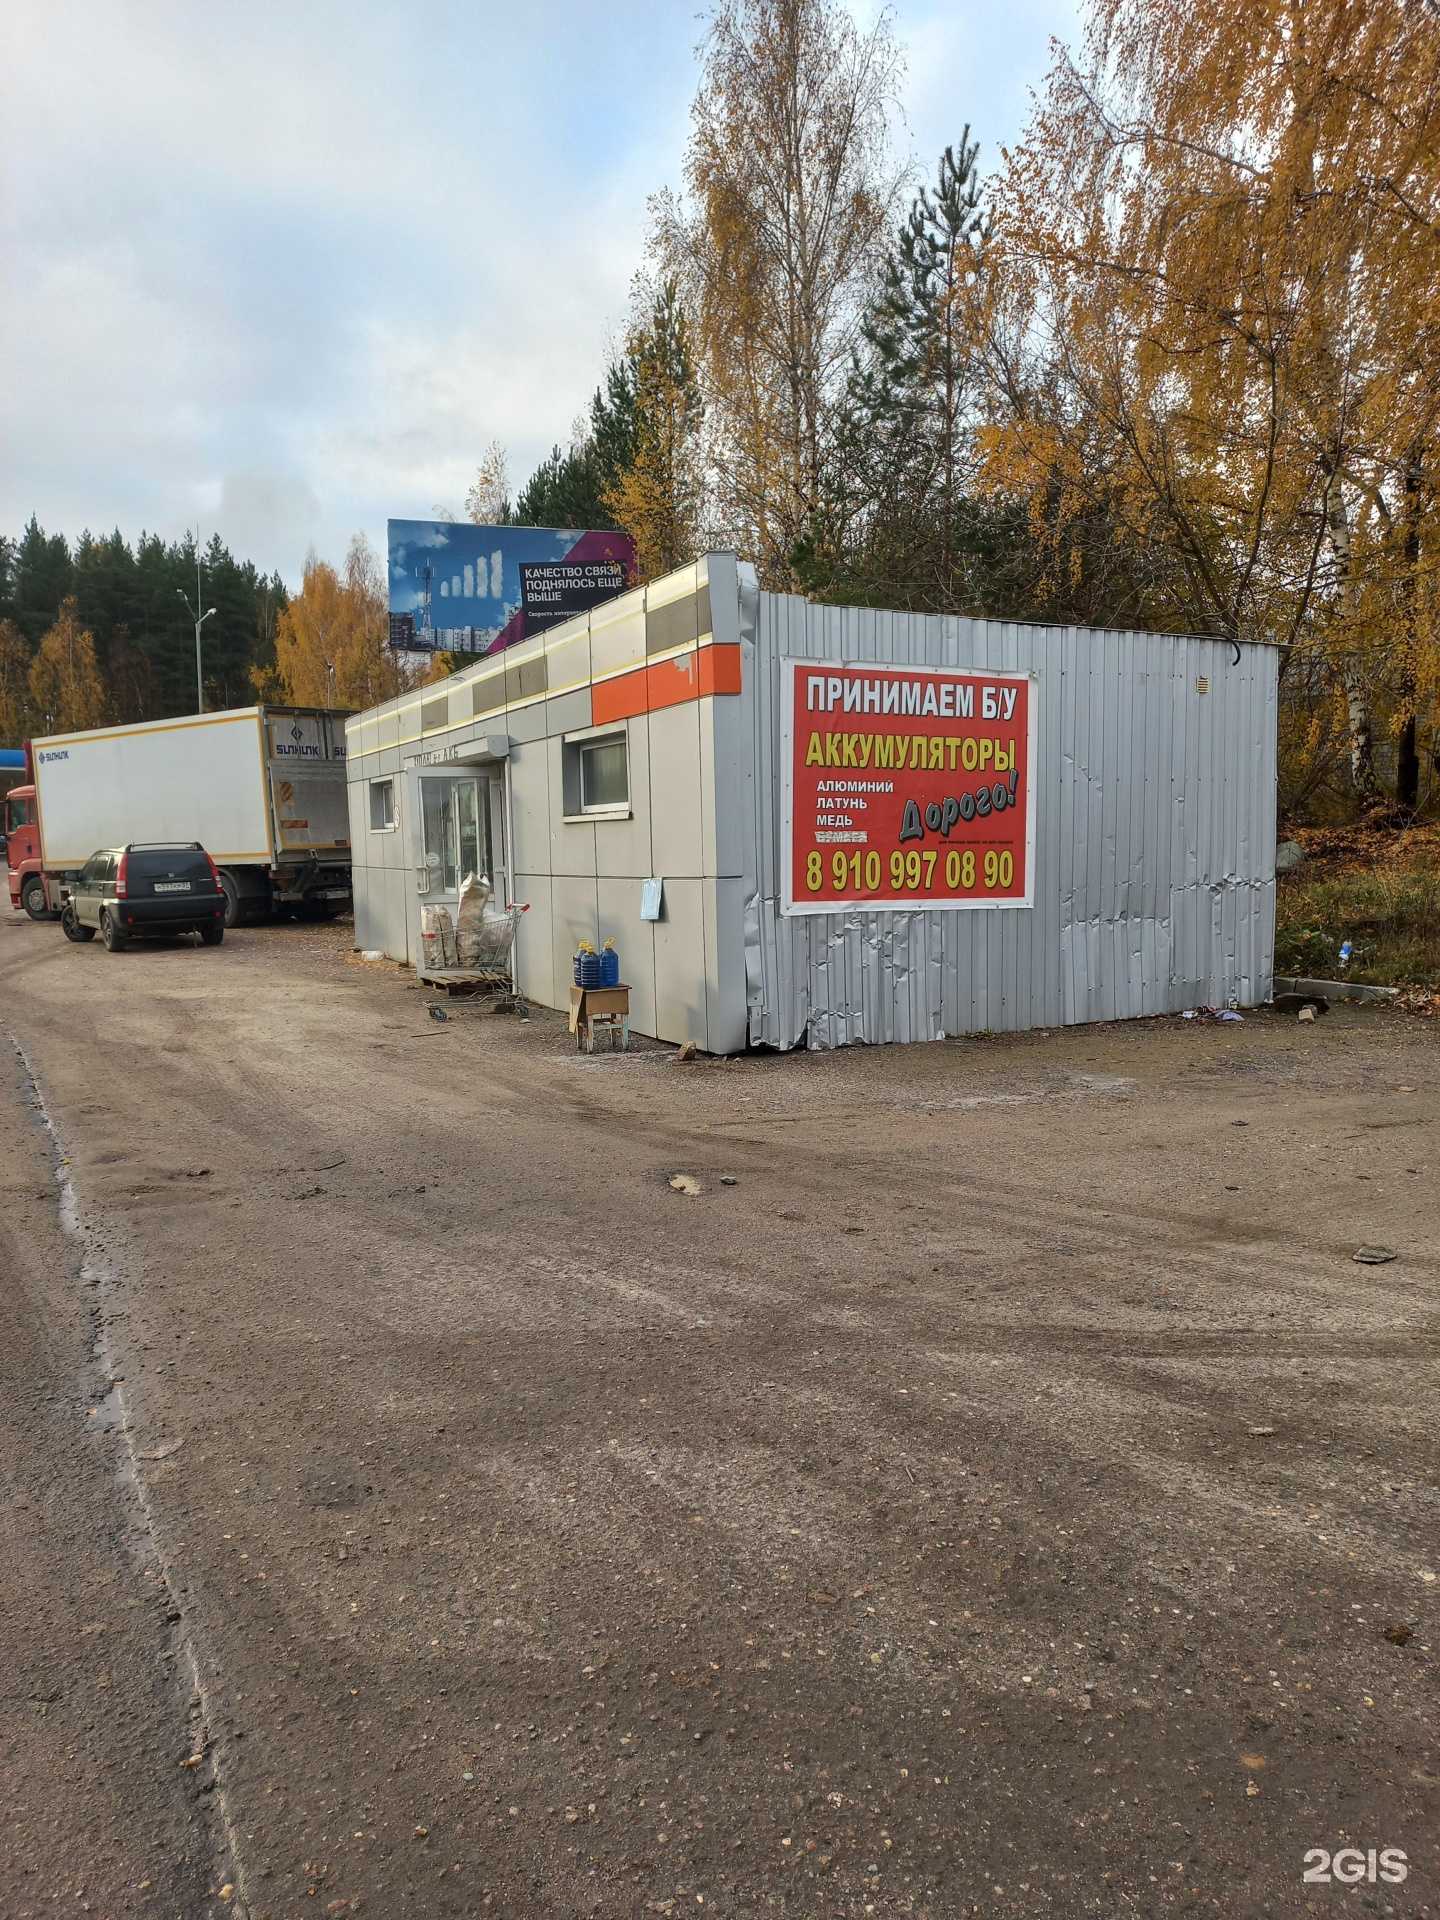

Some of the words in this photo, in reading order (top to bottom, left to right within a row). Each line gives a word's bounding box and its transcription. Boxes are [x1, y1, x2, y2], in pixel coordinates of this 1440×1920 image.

[525, 567, 583, 579] КАЧЕСТВО
[526, 579, 596, 591] ПОДНЯЛОСЬ
[598, 577, 623, 588] ЕЩЕ
[527, 591, 562, 602] ВЫШЕ
[807, 676, 974, 718] ПРИНИМАЕМ
[982, 686, 1018, 721] Б/У
[805, 732, 1015, 771] АККУМУЛЯТОРЫ
[816, 780, 894, 793] АЛЮМИНИЙ
[816, 797, 868, 809] ЛАТУНЬ
[899, 769, 1019, 844] Дорого!
[816, 815, 853, 828] МЕДЬ
[806, 850, 823, 891] 8
[832, 850, 881, 890] 910
[890, 850, 937, 889] 997
[945, 850, 976, 889] 08
[984, 850, 1014, 888] 90
